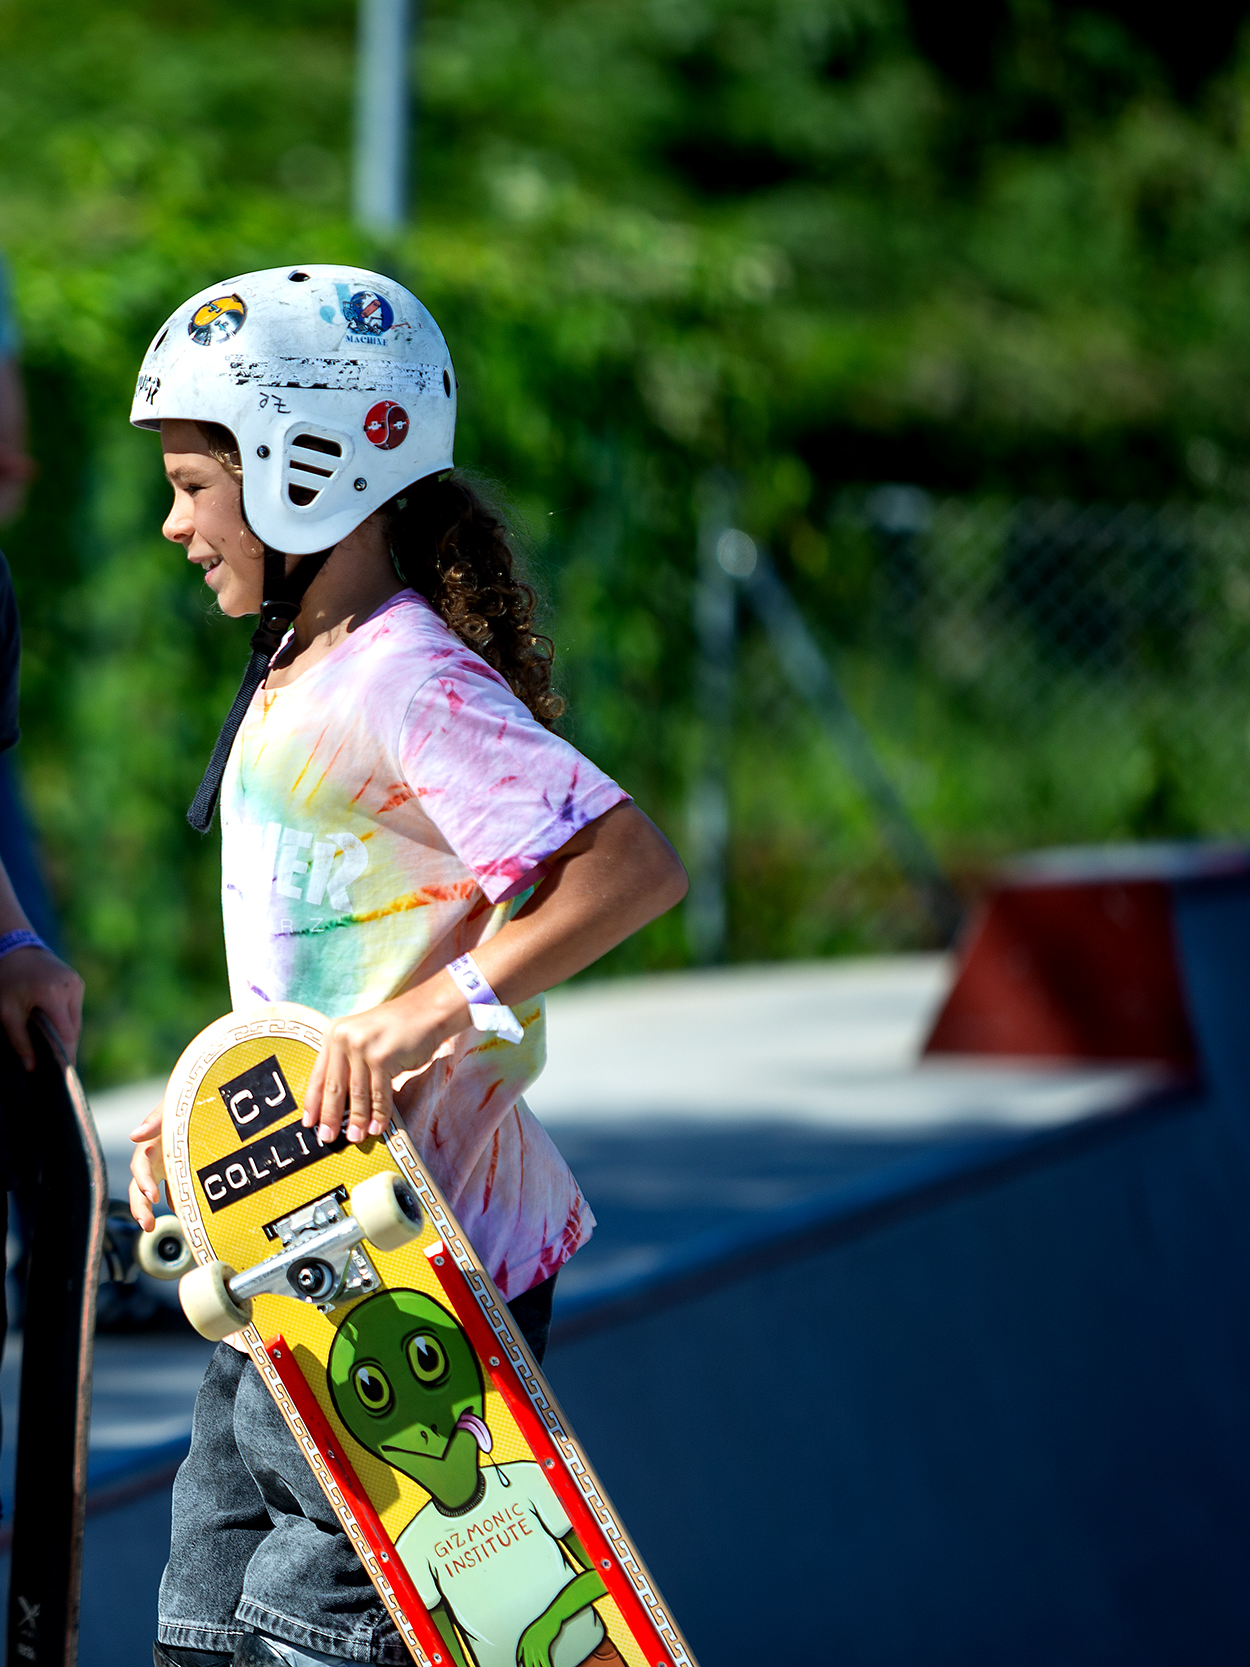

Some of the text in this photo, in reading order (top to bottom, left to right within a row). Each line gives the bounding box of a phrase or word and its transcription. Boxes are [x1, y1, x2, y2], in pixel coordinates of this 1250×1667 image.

[230, 1070, 287, 1125] CJ
[204, 1112, 350, 1201] COLLI
[434, 1502, 524, 1558] GIZMONIC
[444, 1517, 534, 1578] INSTITUTE
